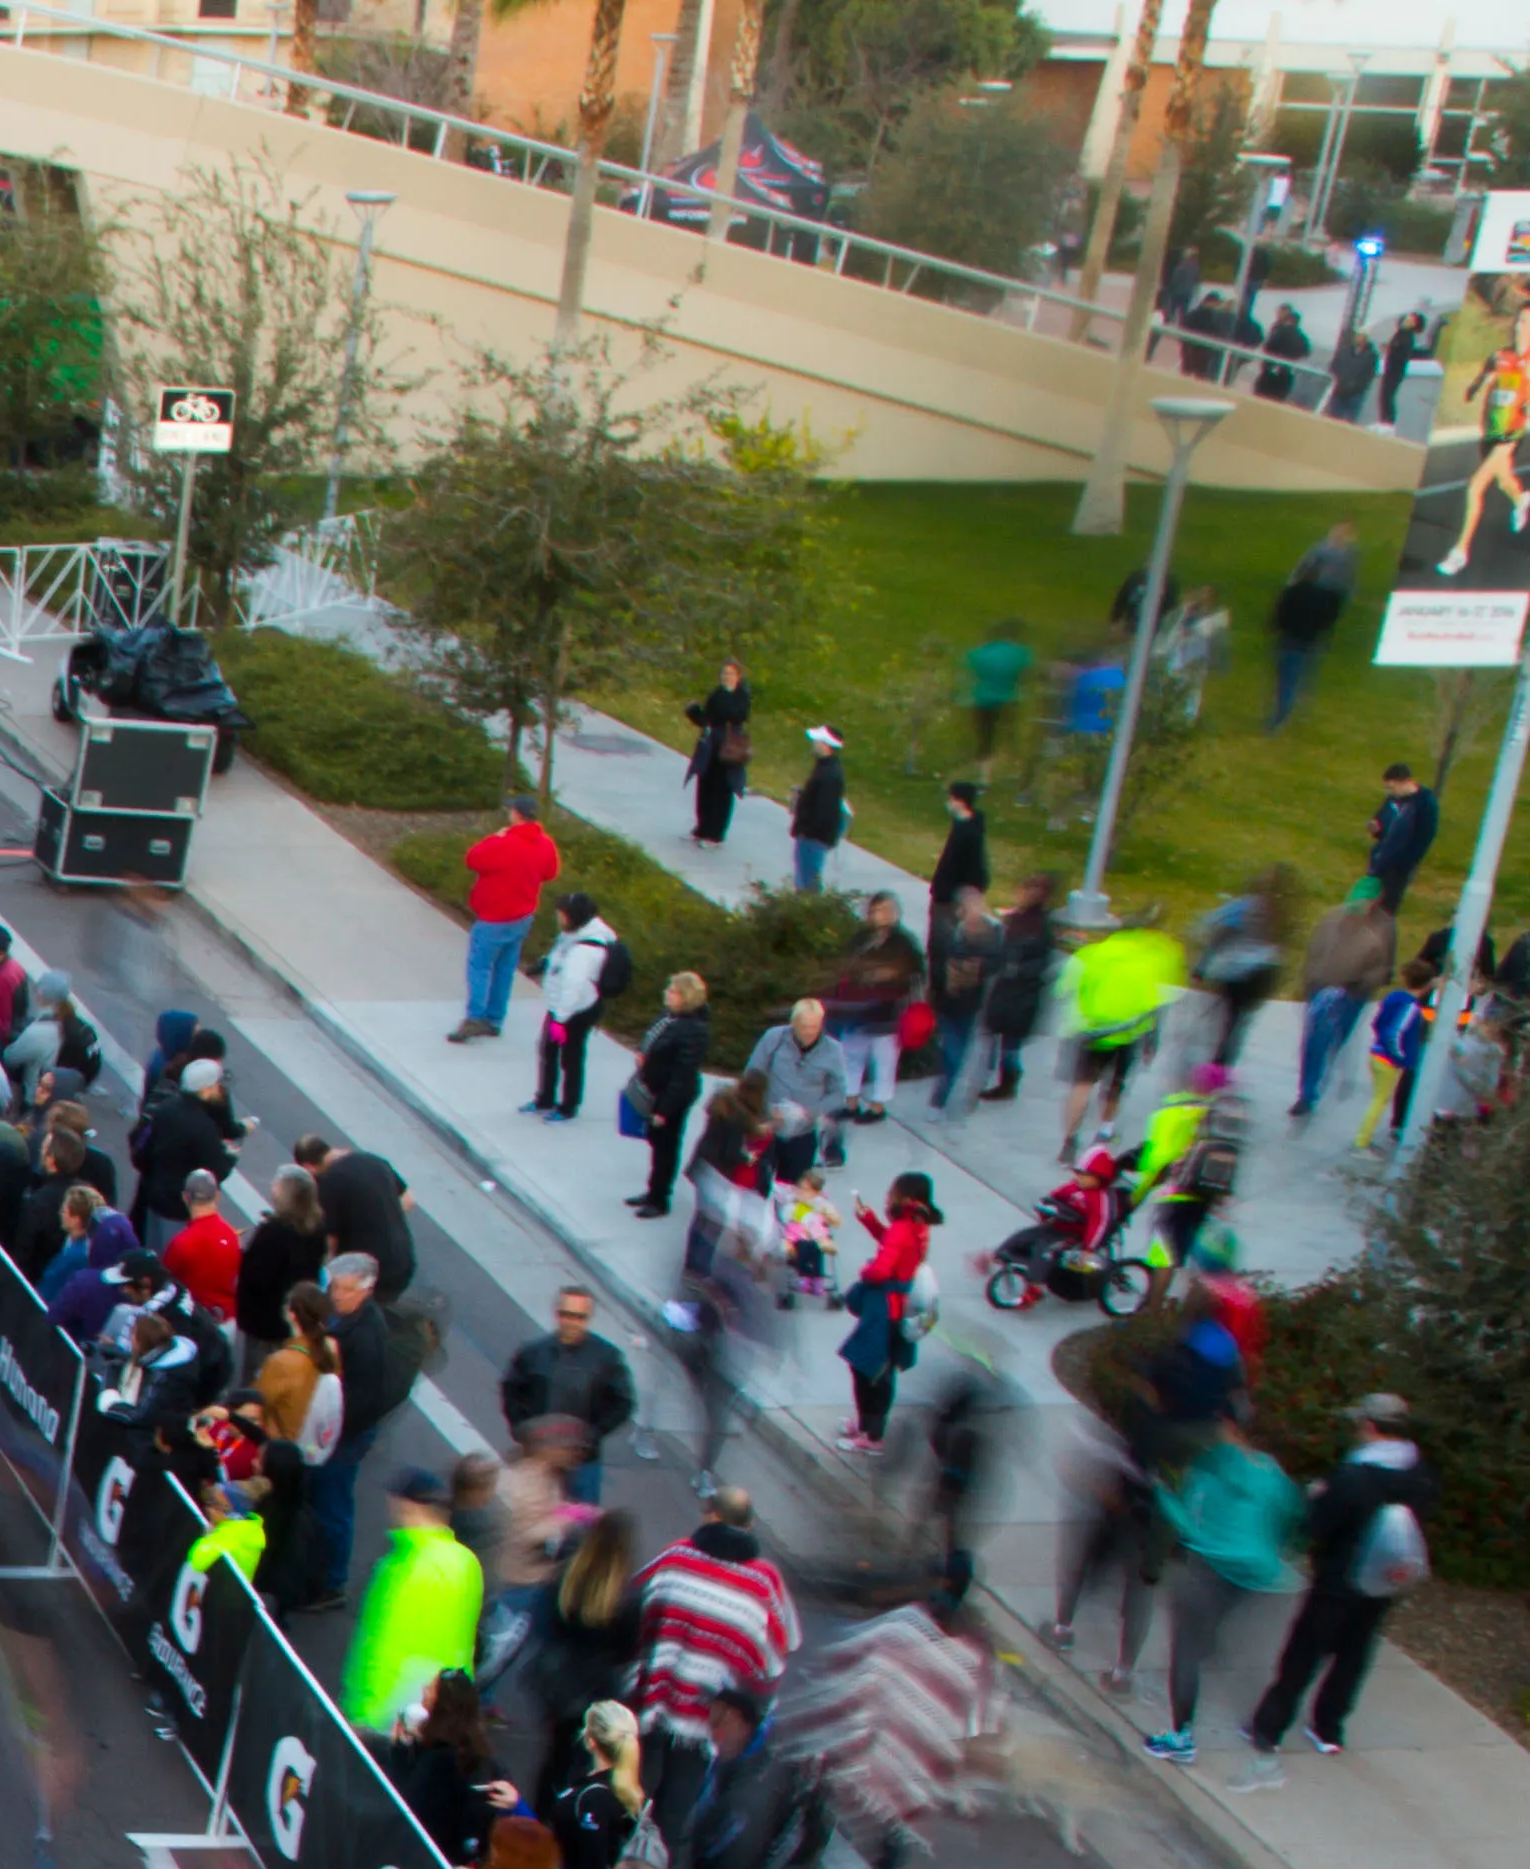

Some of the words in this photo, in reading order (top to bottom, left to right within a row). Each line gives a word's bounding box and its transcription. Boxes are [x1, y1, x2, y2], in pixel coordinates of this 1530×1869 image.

[96, 1455, 137, 1546] G
[170, 1560, 210, 1655] G
[266, 1735, 318, 1862] G
